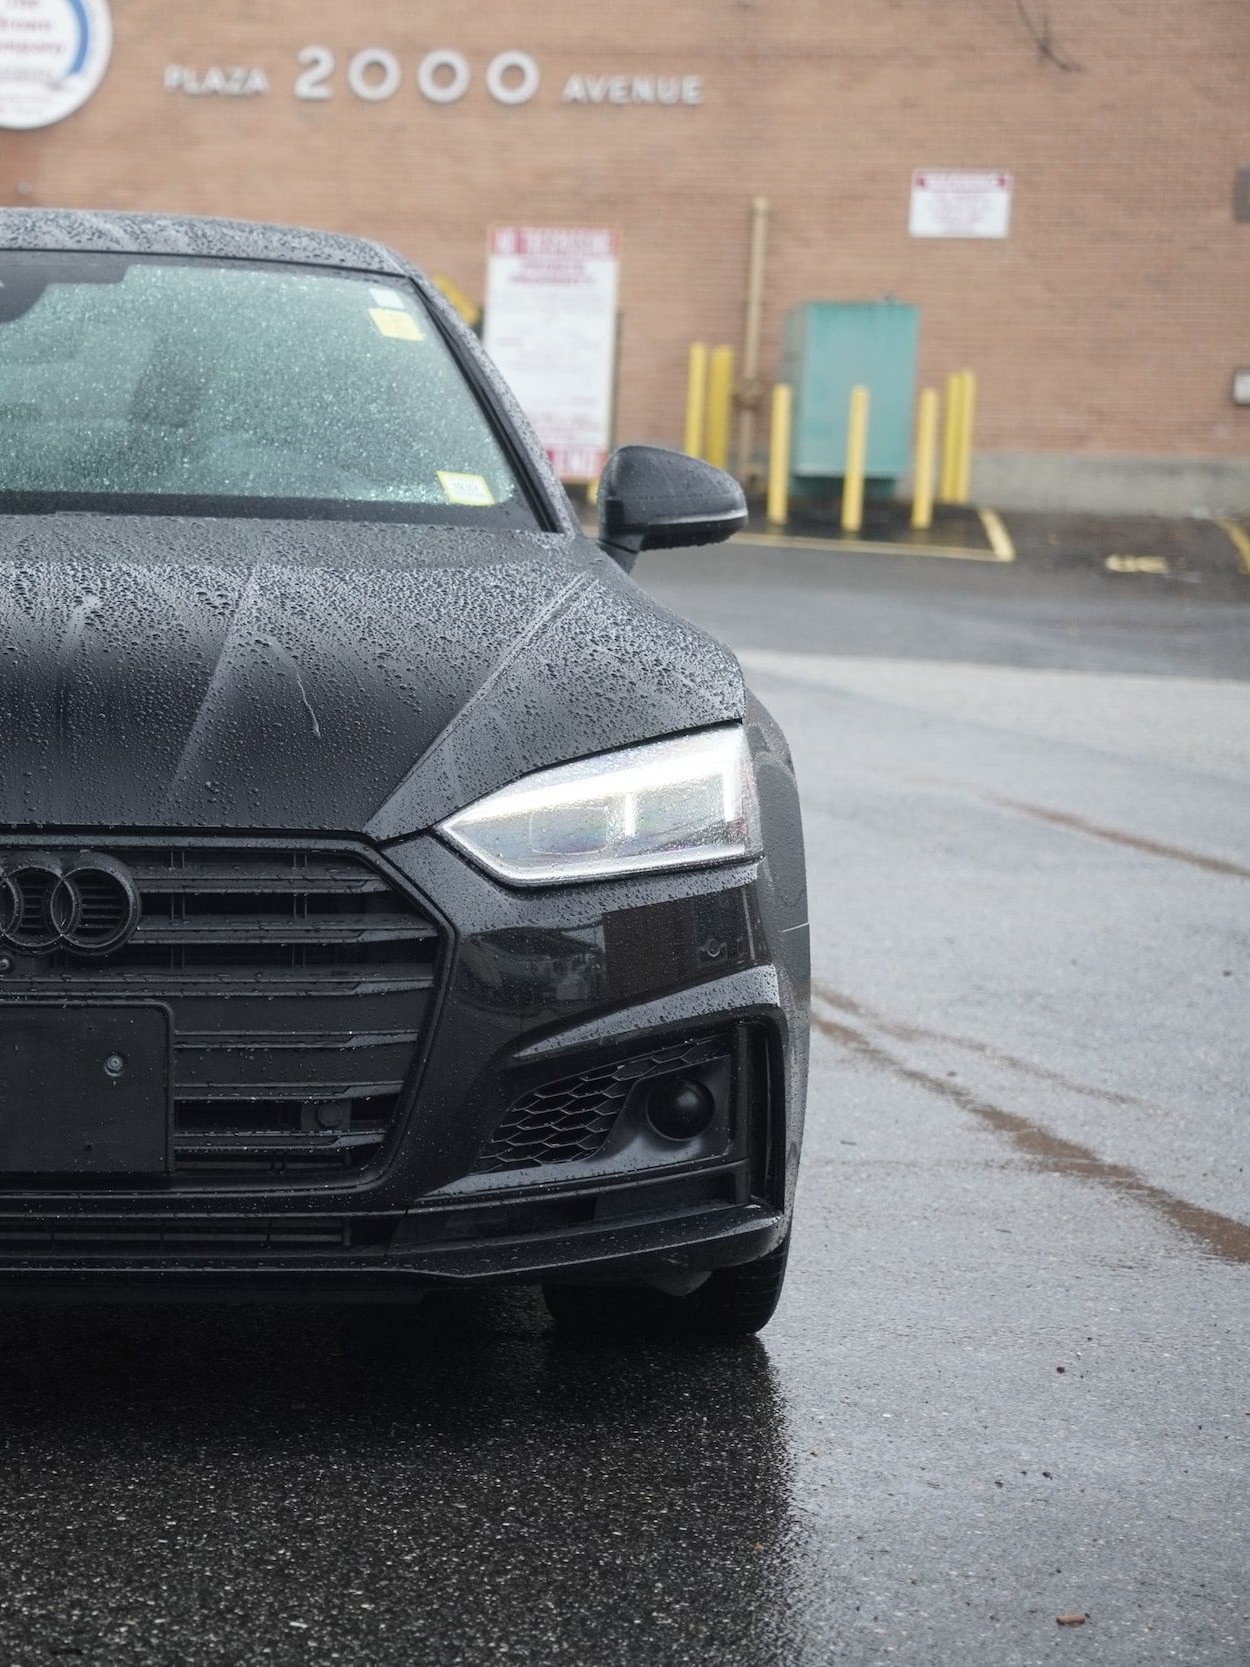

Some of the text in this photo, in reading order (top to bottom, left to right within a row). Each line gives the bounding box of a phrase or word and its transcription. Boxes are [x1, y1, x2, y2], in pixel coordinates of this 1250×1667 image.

[163, 46, 704, 105] PLAZA 2000 AVENUE
